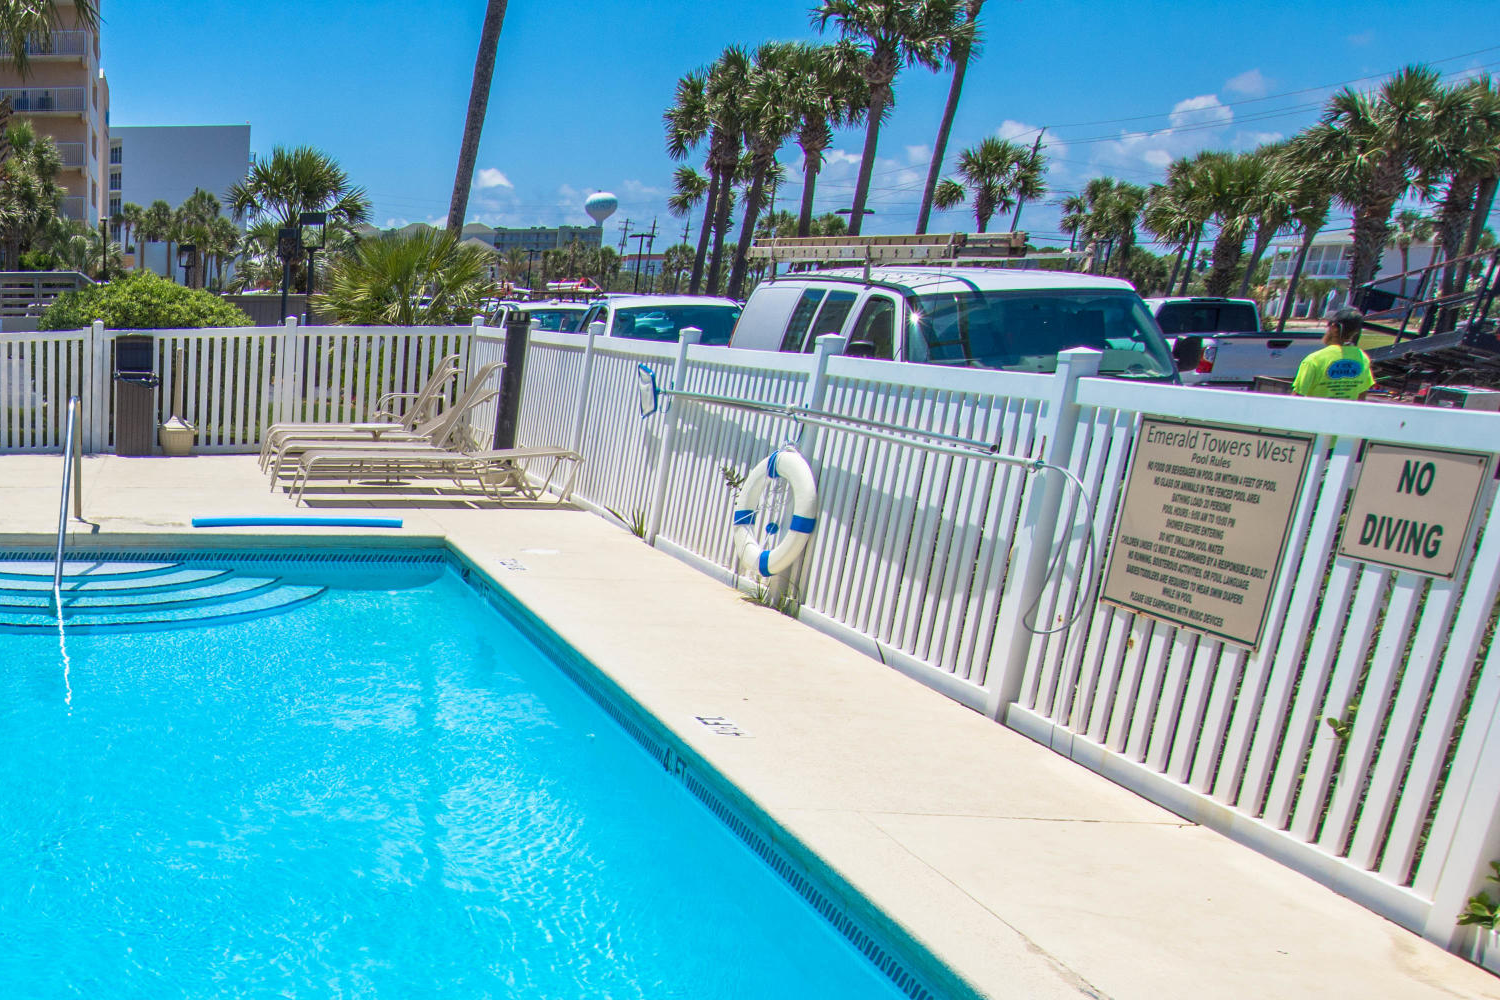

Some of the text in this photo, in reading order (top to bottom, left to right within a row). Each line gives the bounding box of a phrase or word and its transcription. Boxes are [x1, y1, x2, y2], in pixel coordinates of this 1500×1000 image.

[1147, 426, 1296, 464] Emerald Towers West
[1190, 453, 1232, 468] Pool Rules
[1148, 461, 1153, 470] NO
[1154, 462, 1164, 472] FOOD
[1165, 464, 1171, 473] OR
[1172, 465, 1196, 477] BEVERAGES
[1196, 469, 1201, 478] IN
[1202, 470, 1214, 480] POOL
[1214, 472, 1221, 481] OR
[1222, 473, 1239, 484] WITHIN
[1243, 476, 1255, 487] FEET
[1256, 478, 1263, 488] OF
[1263, 480, 1277, 491] POOL
[1154, 476, 1260, 504] NO GLASS OR ANIMALS IN THE FENCED POOL AREA
[1396, 460, 1436, 496] NO
[1162, 504, 1173, 514] POOL
[1174, 507, 1188, 517] HOURS
[1200, 512, 1208, 522] AM
[1208, 514, 1214, 523] TO
[1228, 518, 1235, 527] PM
[1210, 500, 1231, 513] PERSONS
[1159, 532, 1224, 555] DO NOT SWALLOW POOL WATER
[1184, 523, 1200, 534] BEFORE
[1201, 526, 1224, 539] ENTERING
[1358, 514, 1444, 559] DIVING
[1121, 535, 1139, 547] CHILDREN
[1139, 540, 1152, 550] UNDER
[1158, 544, 1169, 555] MUST
[1170, 547, 1176, 556] BE
[1176, 549, 1206, 564] ACCOMPANIED
[1207, 556, 1213, 566] BY
[1218, 559, 1250, 575] RESPONSIBLE
[1250, 567, 1267, 579] ADULT
[1128, 550, 1133, 559] NO
[1203, 570, 1210, 580] OR
[1223, 575, 1250, 590] LANGUAGE
[1162, 587, 1193, 603] WHILE IN POOL
[1168, 576, 1189, 589] REQUIRED
[1190, 582, 1196, 591] TO
[1196, 583, 1209, 595] WEAR
[1130, 591, 1144, 603] PLEASE
[1177, 605, 1188, 616] WITH
[1204, 613, 1224, 627] DEVICES
